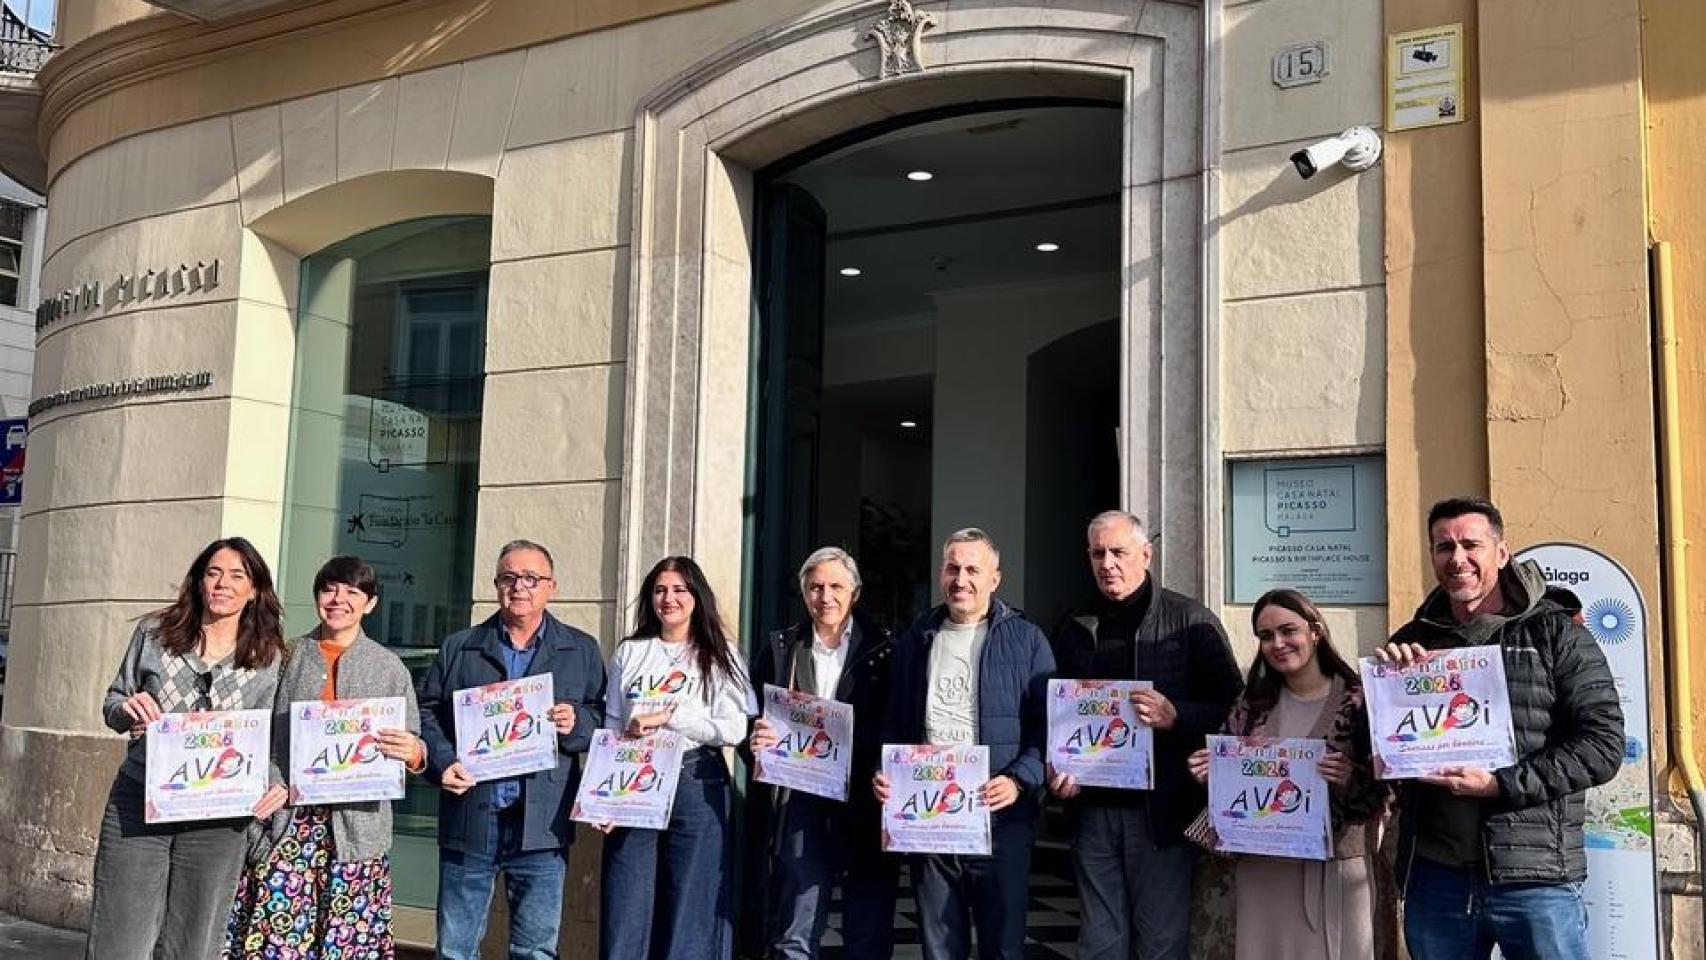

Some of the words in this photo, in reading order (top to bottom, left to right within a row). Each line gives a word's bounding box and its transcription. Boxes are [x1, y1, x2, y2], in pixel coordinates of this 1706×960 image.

[1277, 500, 1327, 511] PICASSO
[1545, 566, 1590, 585] álaga
[1404, 674, 1463, 695] 2026
[1078, 700, 1120, 716] 2026
[325, 719, 371, 735] 2026
[184, 731, 235, 749] 2026
[912, 765, 955, 780] 2026
[1241, 759, 1290, 777] 2026
